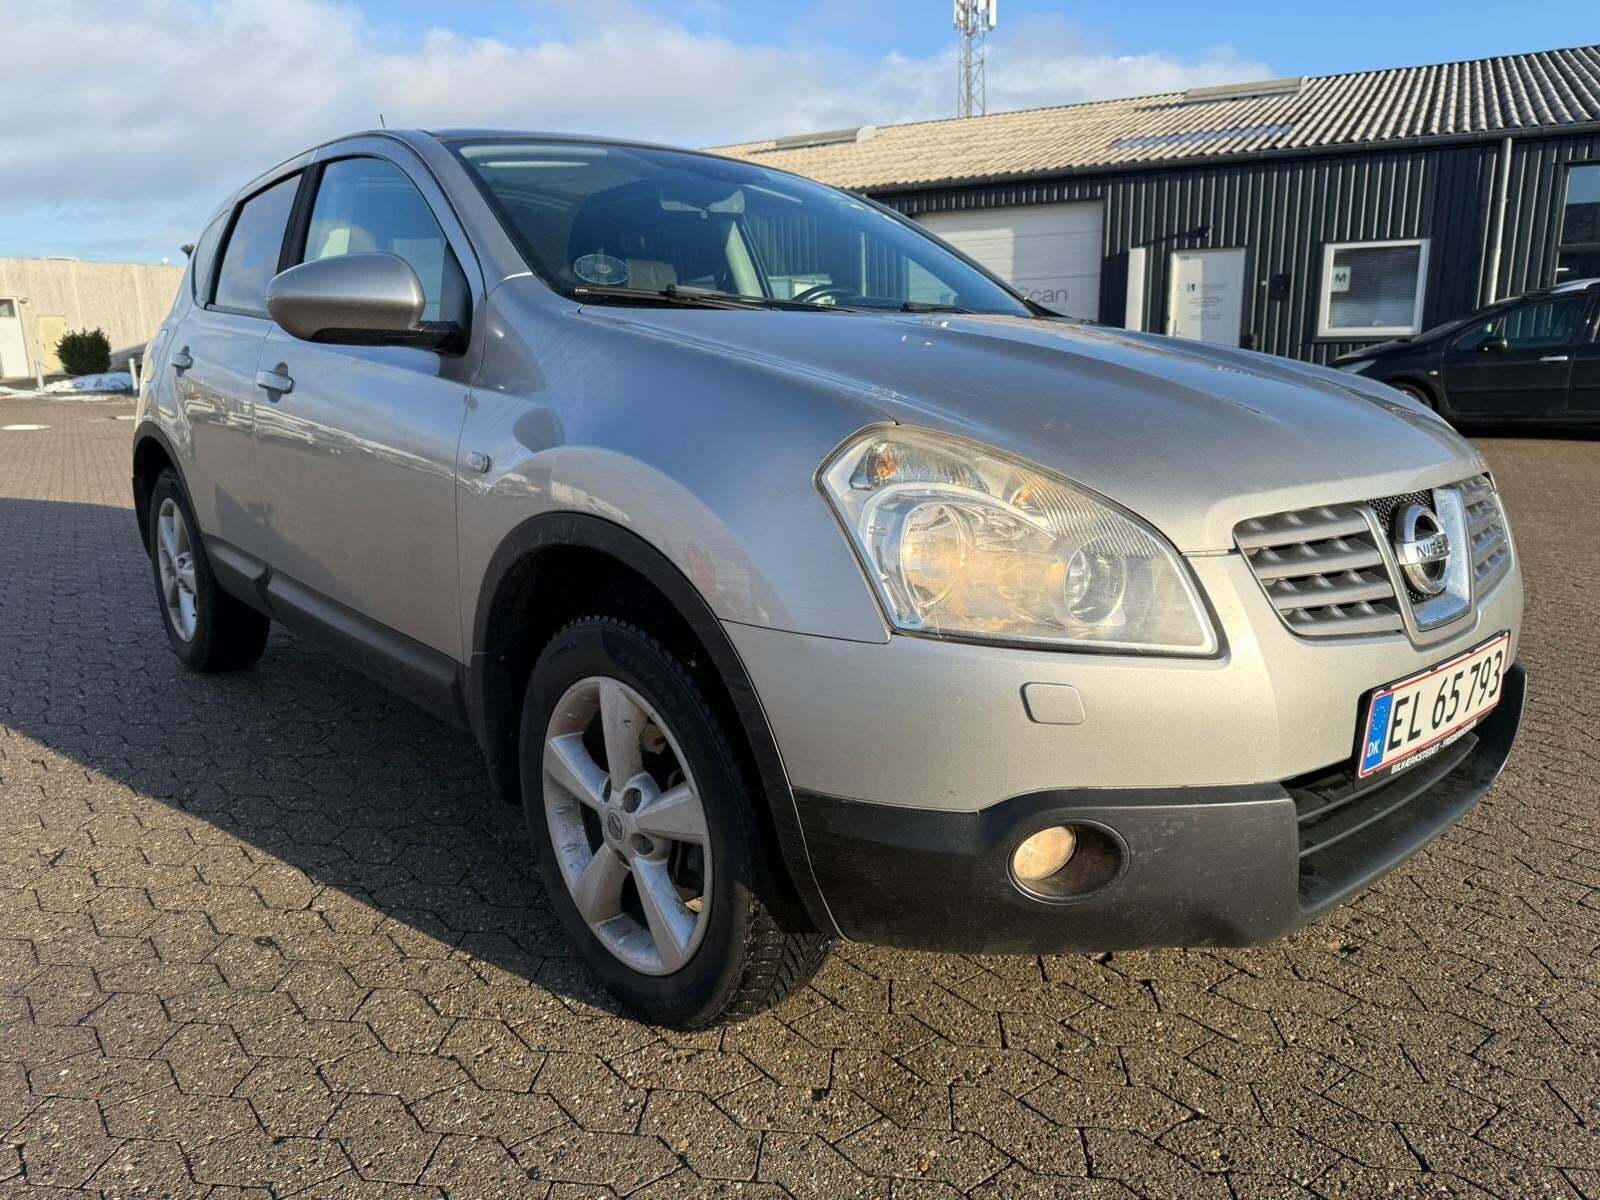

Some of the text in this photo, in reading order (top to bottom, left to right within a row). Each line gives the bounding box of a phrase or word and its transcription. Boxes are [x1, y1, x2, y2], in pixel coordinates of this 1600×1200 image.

[1334, 273, 1346, 282] M
[1416, 537, 1449, 559] NISS
[1388, 691, 1421, 752] EL
[1367, 740, 1380, 757] DK
